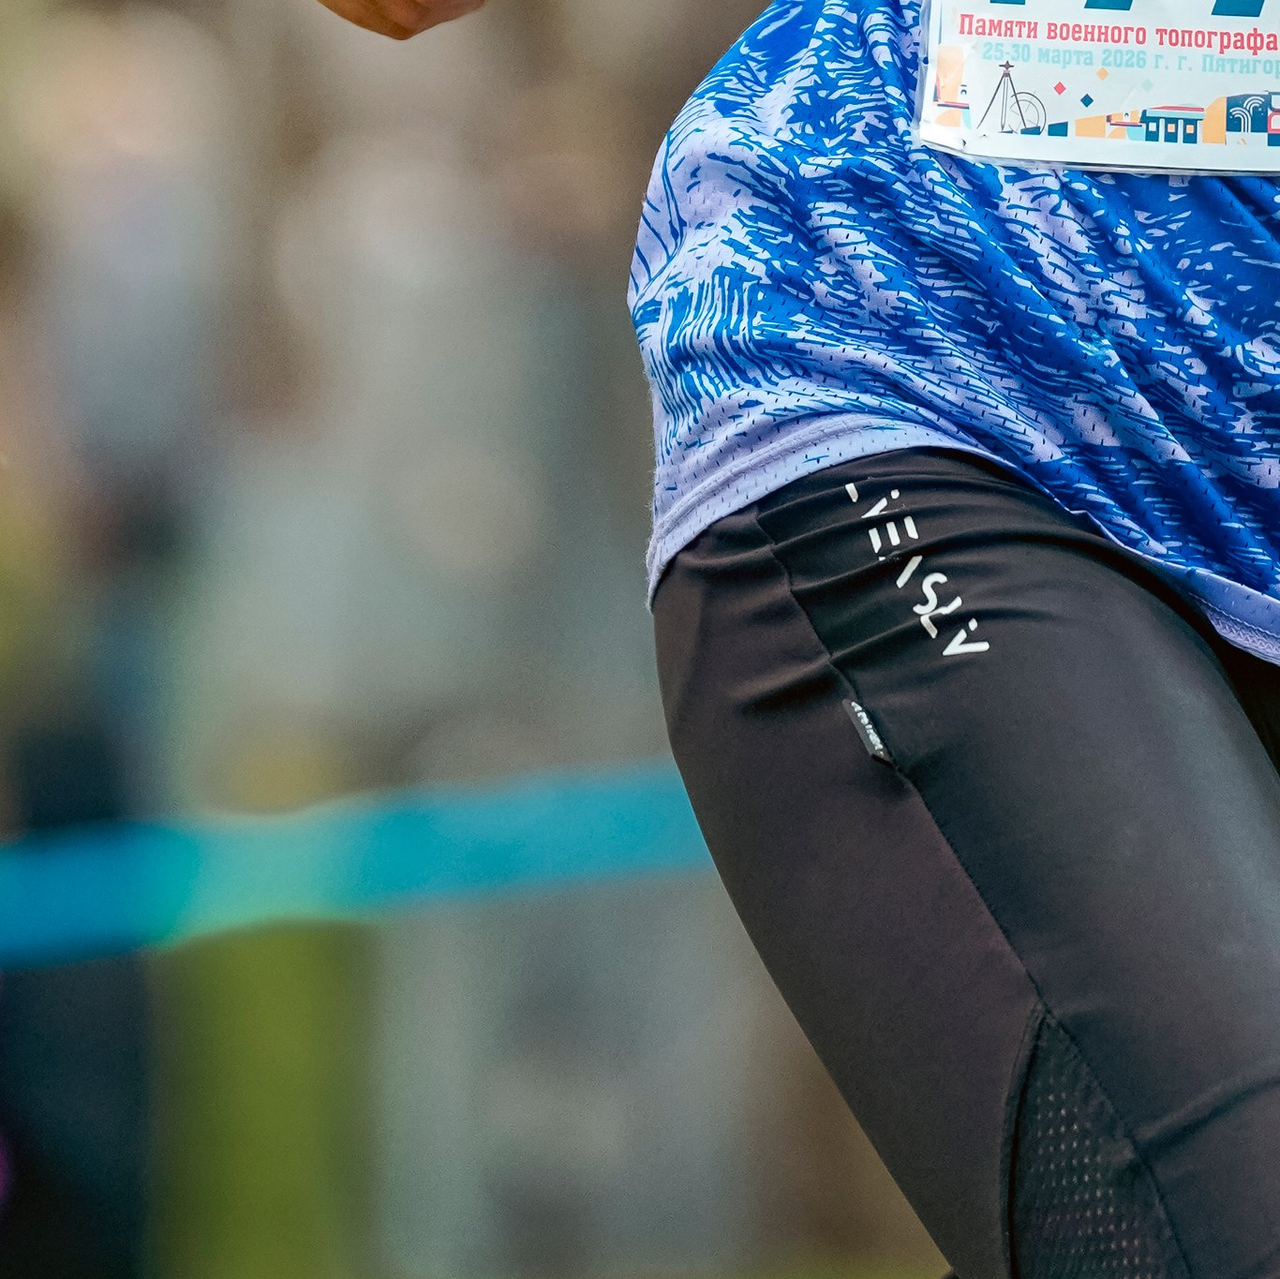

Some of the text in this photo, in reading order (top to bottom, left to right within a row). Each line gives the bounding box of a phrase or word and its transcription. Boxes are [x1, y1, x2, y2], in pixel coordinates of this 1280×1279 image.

[959, 13, 1038, 39] Памяти
[1046, 22, 1147, 45] военного
[1155, 27, 1278, 56] топографа
[982, 41, 1031, 63] 25-30
[1037, 47, 1094, 70] марта
[1101, 48, 1147, 69] 2026
[1154, 54, 1170, 70] г.
[1177, 55, 1193, 72] г.
